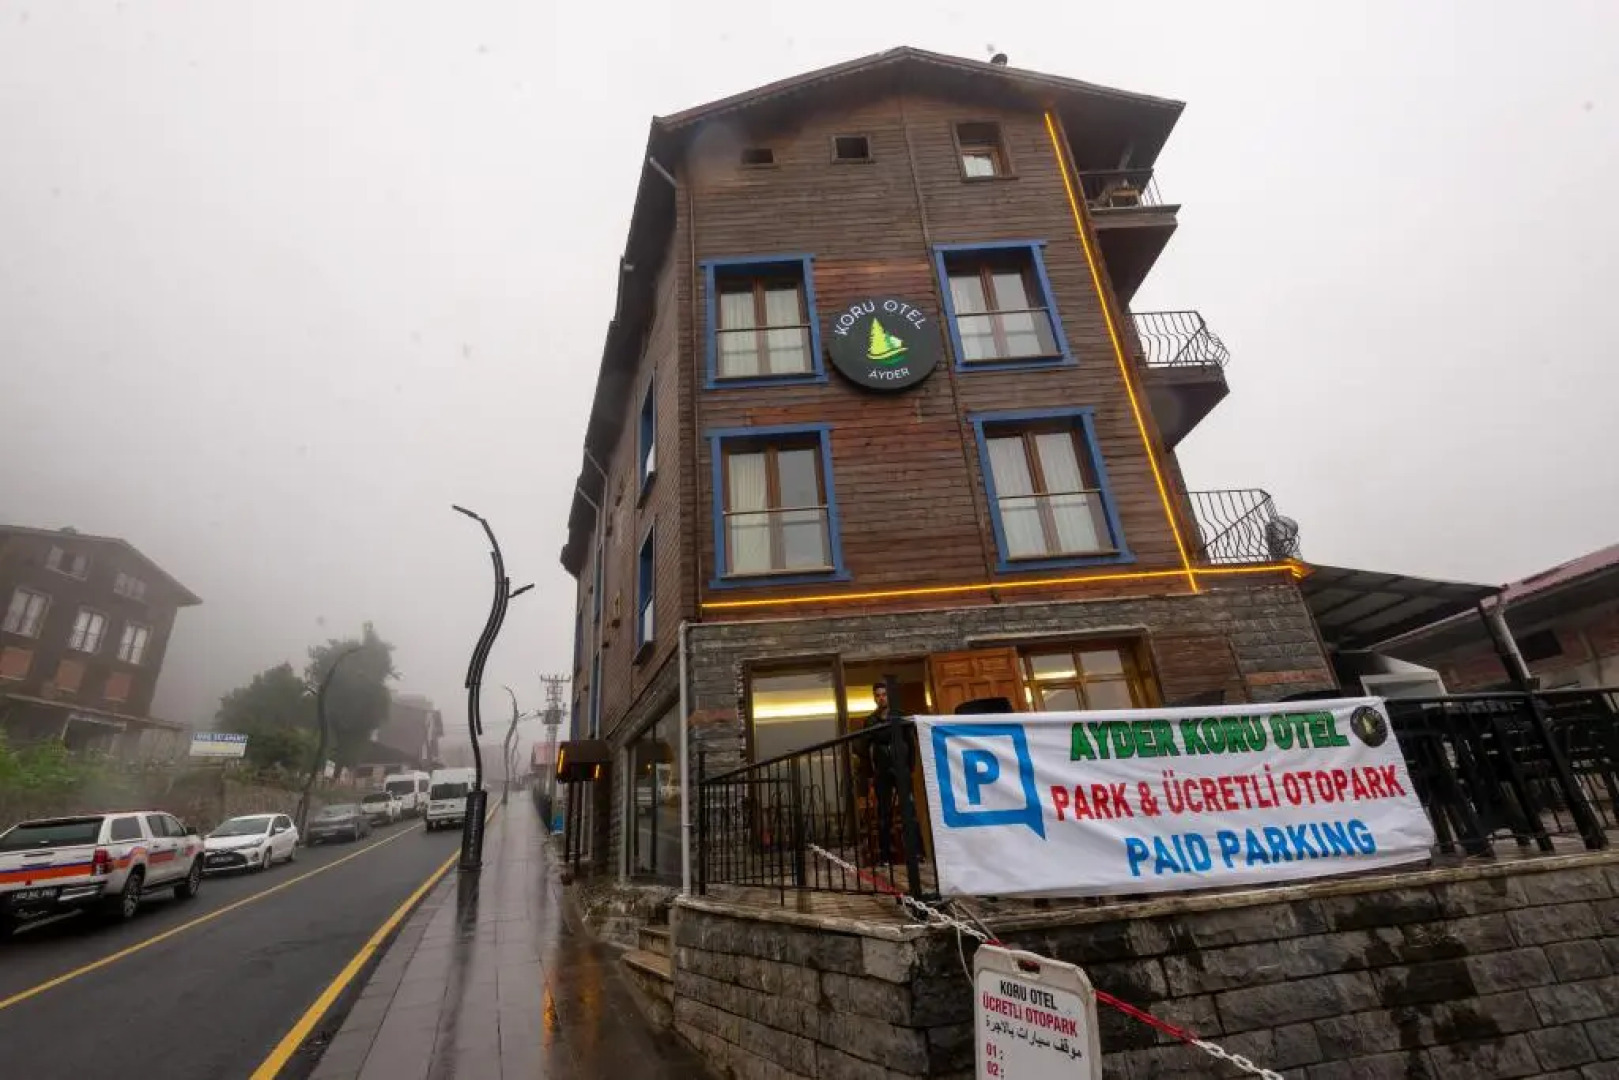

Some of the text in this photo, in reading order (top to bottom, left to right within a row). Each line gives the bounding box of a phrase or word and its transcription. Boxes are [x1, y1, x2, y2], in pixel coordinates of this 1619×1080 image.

[834, 299, 927, 336] KORU OTEL
[868, 367, 911, 380] AYDER
[1070, 718, 1179, 761] AYDER
[1181, 715, 1267, 755] KORU
[1270, 712, 1349, 750] OTEL
[963, 750, 1001, 806] P
[1051, 764, 1405, 821] PARK & ÜCRETLİ OTOPARK
[1125, 820, 1377, 876] PAID PARKING
[1000, 980, 1057, 1010] KORU OTEL
[1025, 1006, 1077, 1038] OTOPARK
